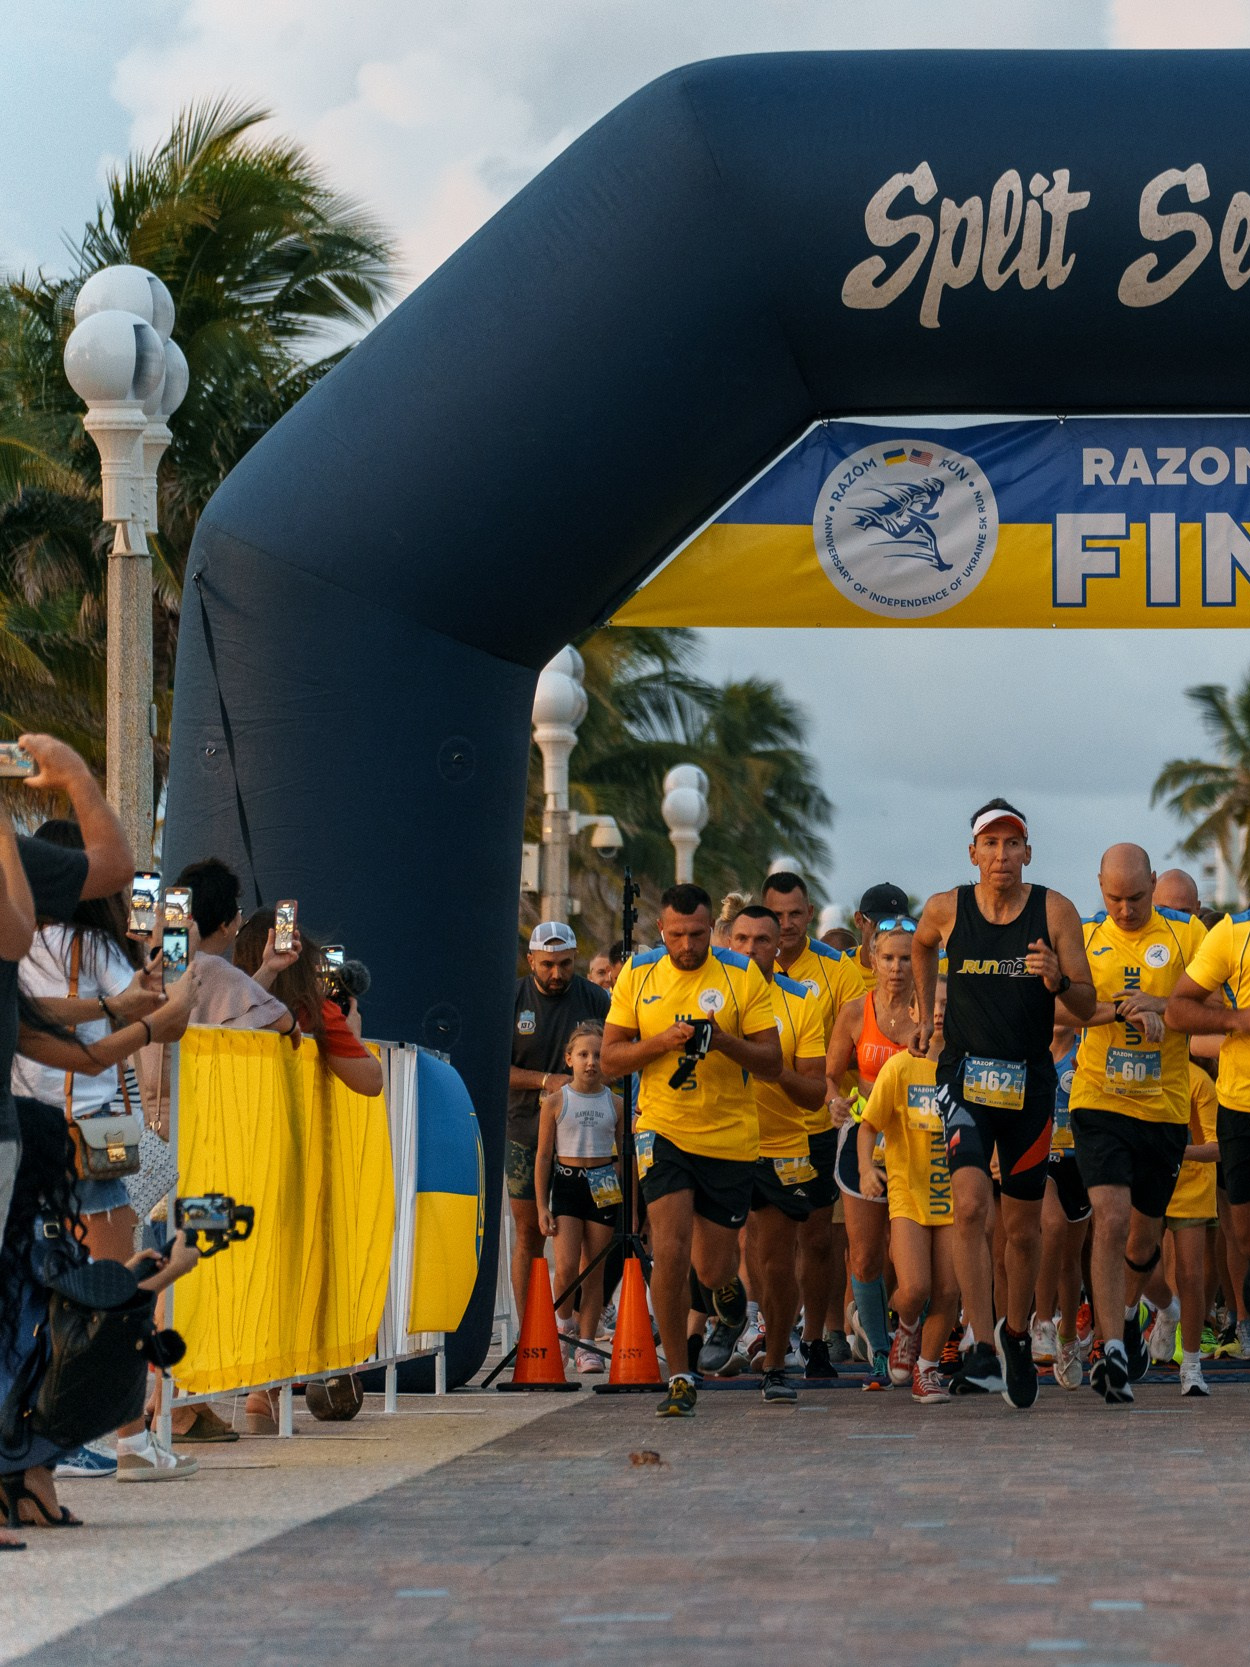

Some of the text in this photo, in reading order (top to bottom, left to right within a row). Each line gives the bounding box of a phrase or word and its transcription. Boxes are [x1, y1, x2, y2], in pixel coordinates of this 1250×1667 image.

[841, 161, 1091, 329] Split
[830, 457, 969, 502] RAZOM RUN
[824, 491, 988, 608] ANNIVERSARY OF INDEPENDENCE OF UKRAINE 5K RUN
[1124, 966, 1142, 1046] UKNE
[1112, 1050, 1133, 1059] RAZOM
[1122, 1061, 1147, 1082] 60
[978, 1070, 1012, 1093] 162
[522, 1347, 548, 1359] SST
